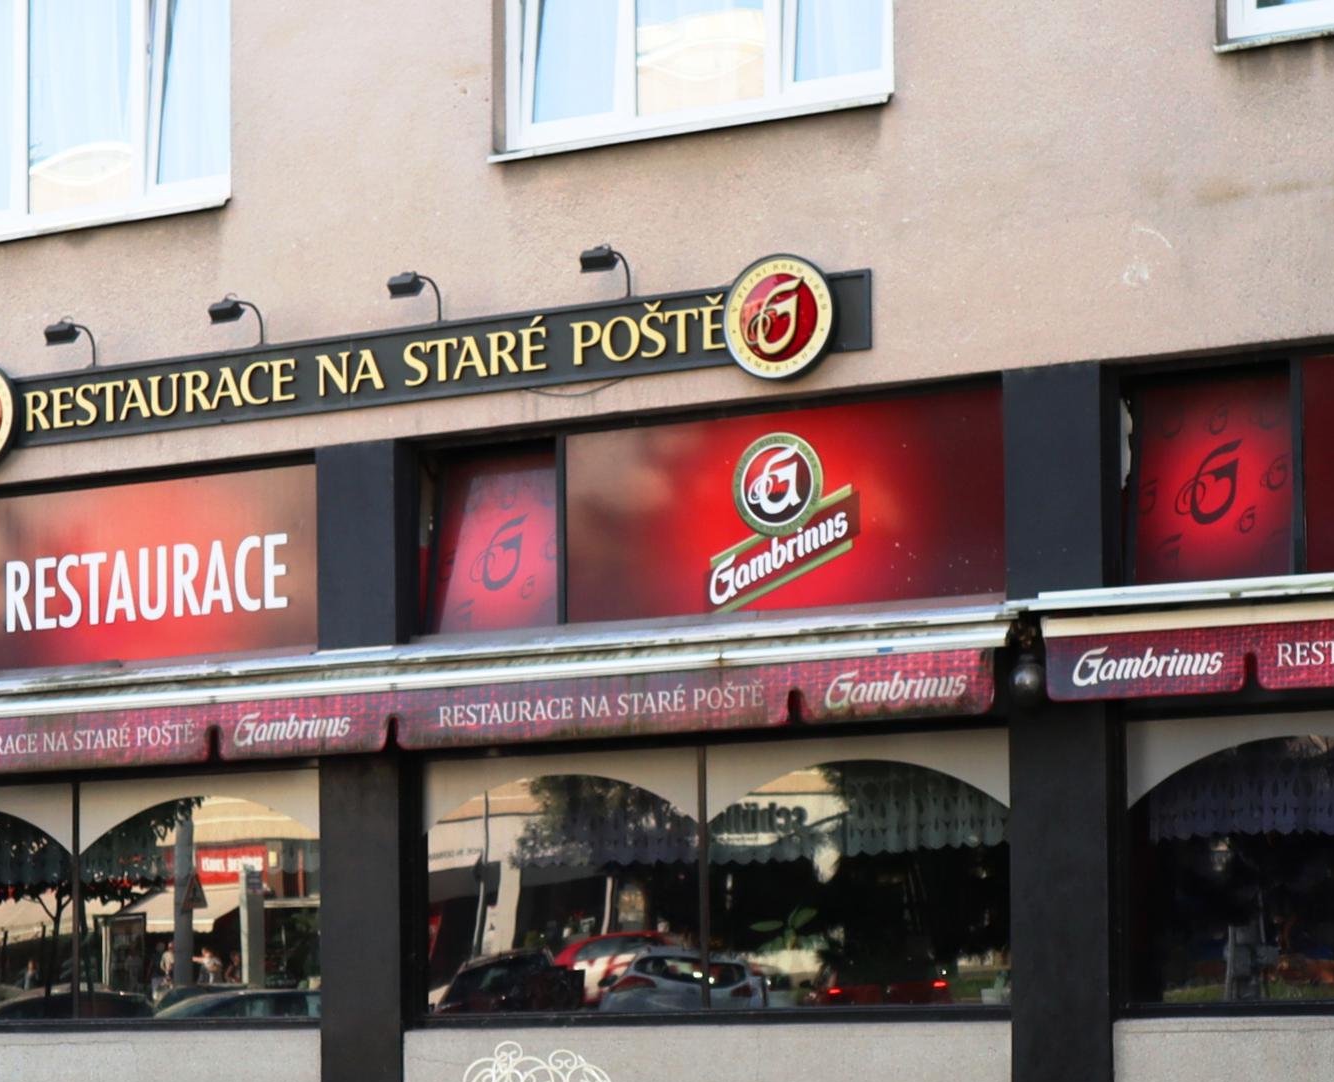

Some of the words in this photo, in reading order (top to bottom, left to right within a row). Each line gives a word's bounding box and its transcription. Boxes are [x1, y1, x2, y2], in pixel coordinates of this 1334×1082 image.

[24, 358, 296, 433] RESTAURACE
[316, 349, 385, 398] NA
[403, 315, 547, 385] STARÉ
[570, 293, 727, 366] POŠTĚ
[709, 511, 849, 605] Gambrinus
[5, 533, 289, 634] RESTAURACE
[824, 668, 968, 709] Gambrinus
[1072, 646, 1224, 687] Gambrinus
[438, 698, 574, 727] RESTAURACE
[579, 694, 611, 718] NA
[616, 684, 686, 716] STARÉ
[692, 677, 764, 710] POŠTĚ
[42, 731, 69, 752] NA
[73, 724, 131, 750] STARÉ
[136, 721, 196, 748] POŠTĚ
[233, 710, 351, 748] Gambrinus
